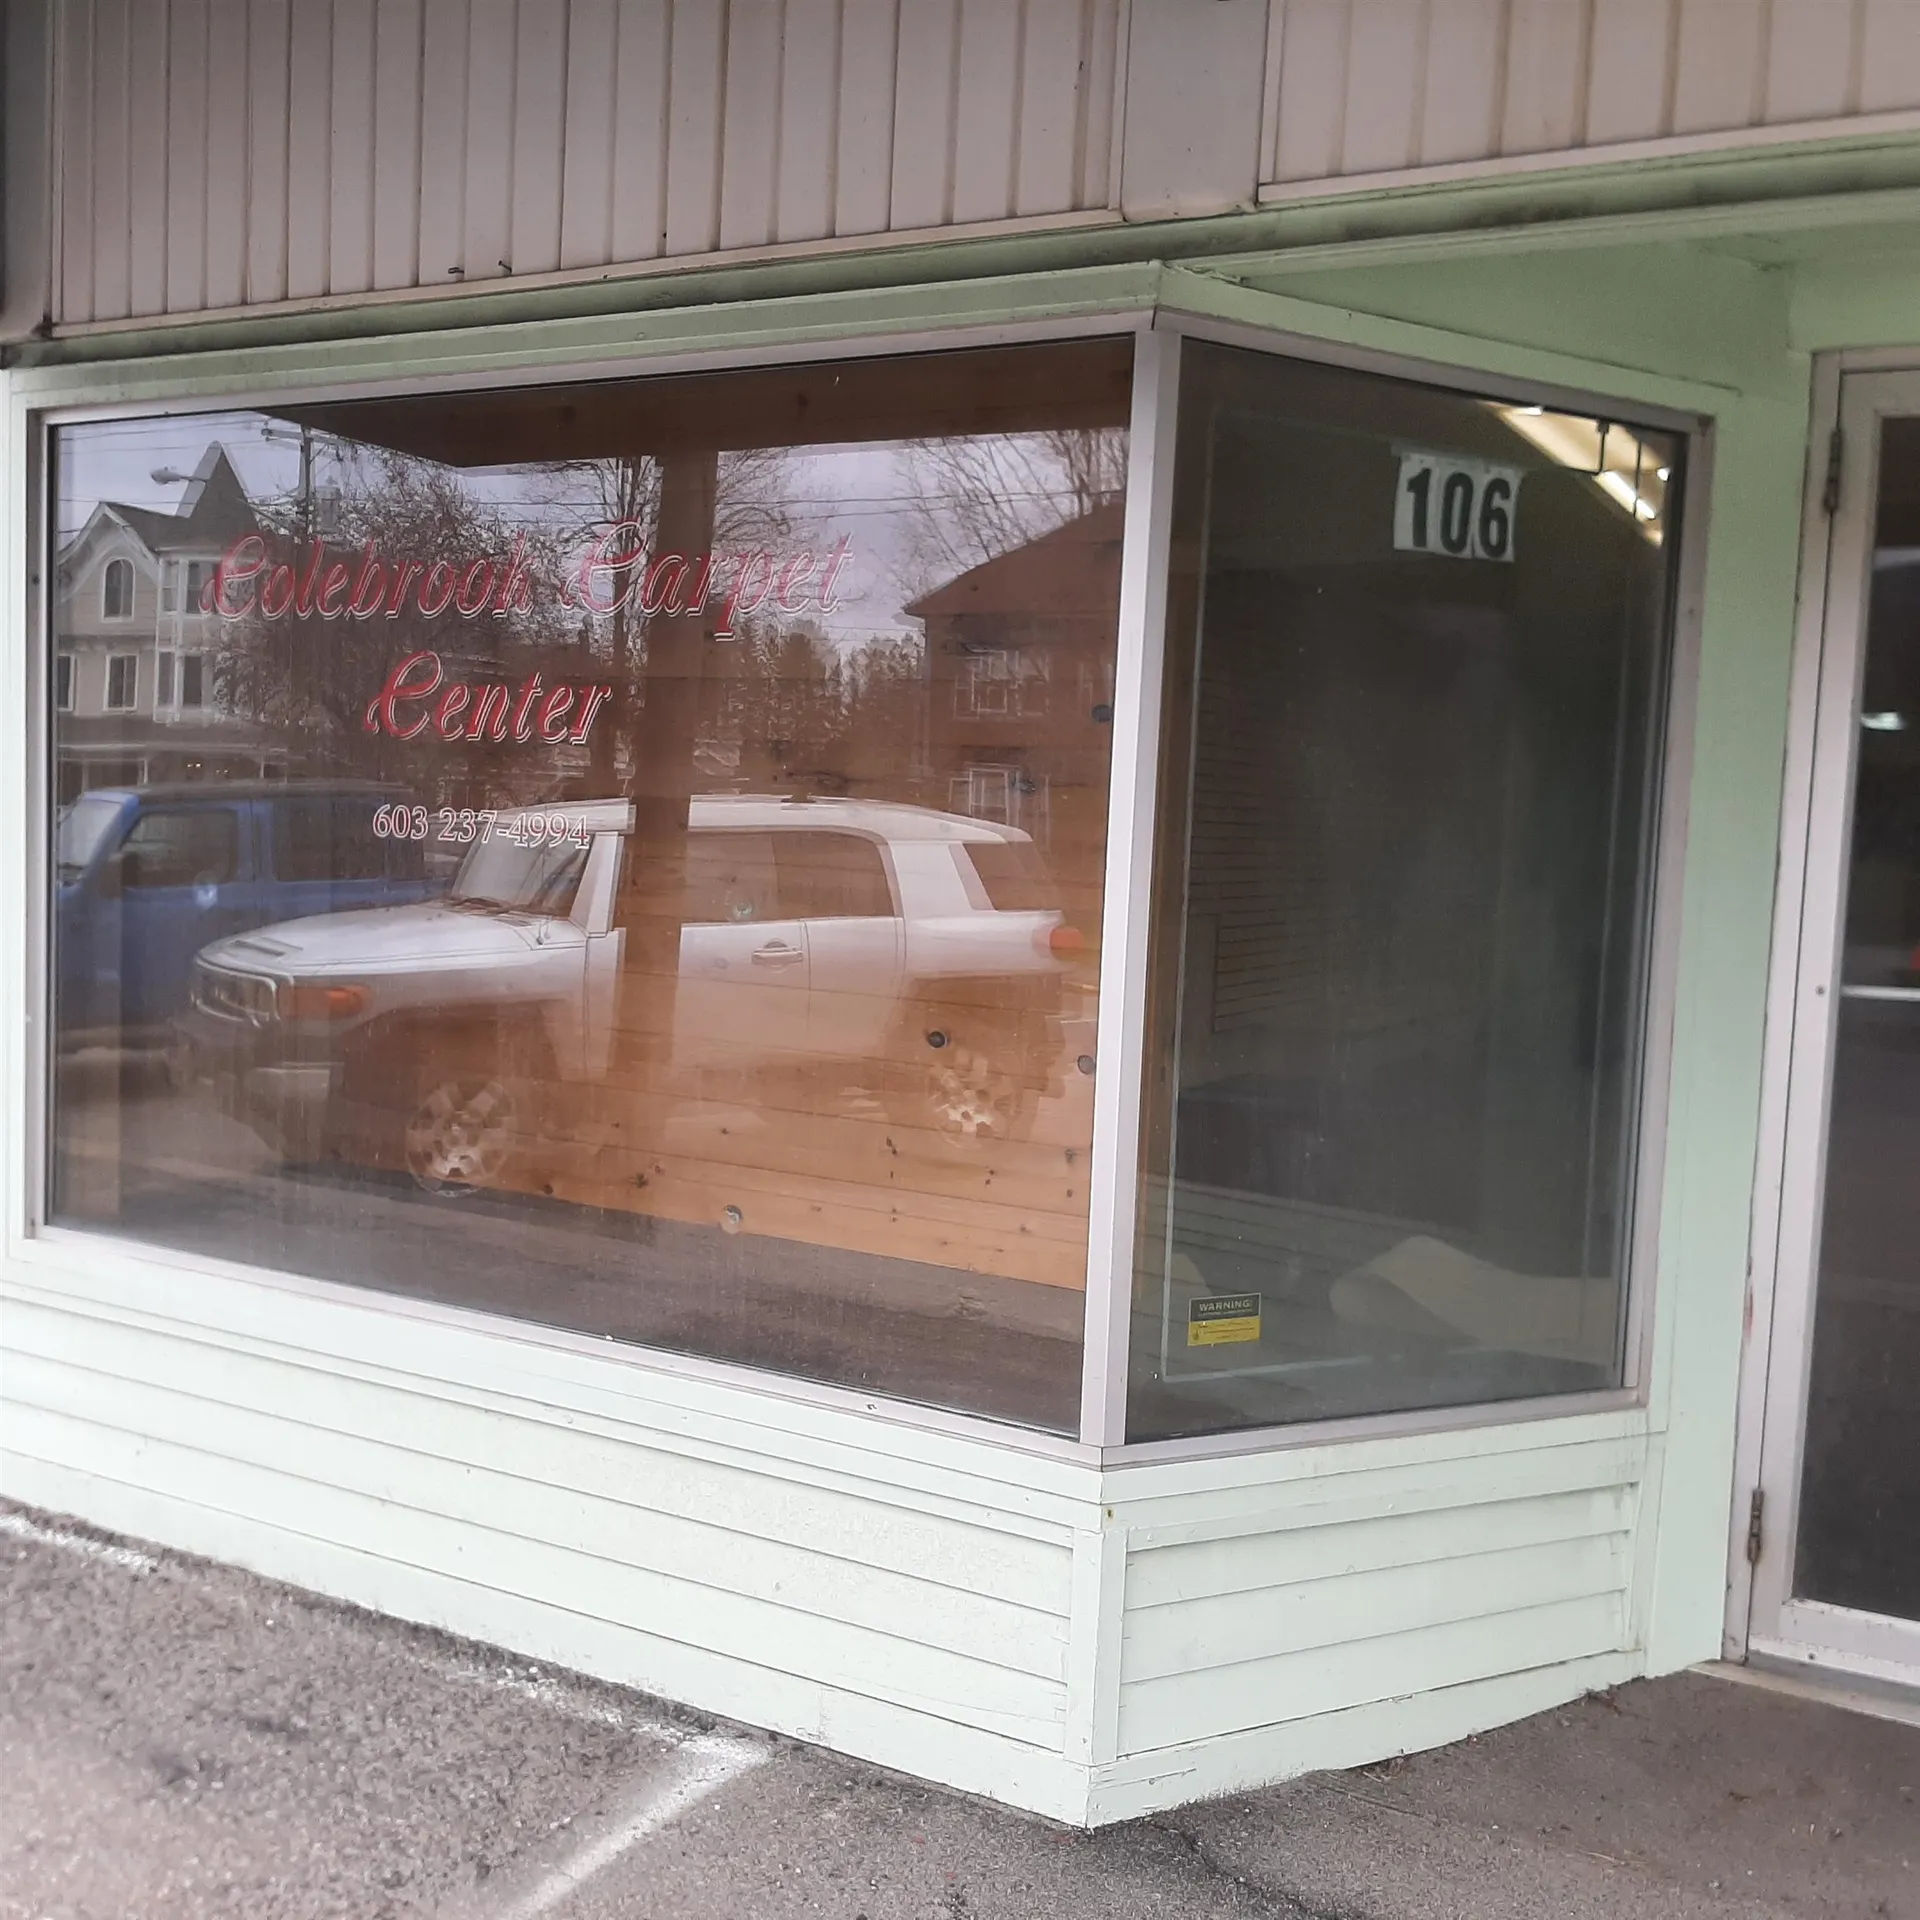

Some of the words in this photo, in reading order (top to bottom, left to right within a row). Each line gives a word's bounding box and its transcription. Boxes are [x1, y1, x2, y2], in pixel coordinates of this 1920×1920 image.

[1407, 468, 1510, 558] 106
[201, 530, 539, 619] Colebrook
[559, 519, 854, 641] Carpet
[364, 650, 612, 744] Center
[372, 804, 429, 839] 603
[437, 808, 590, 849] 237-4994
